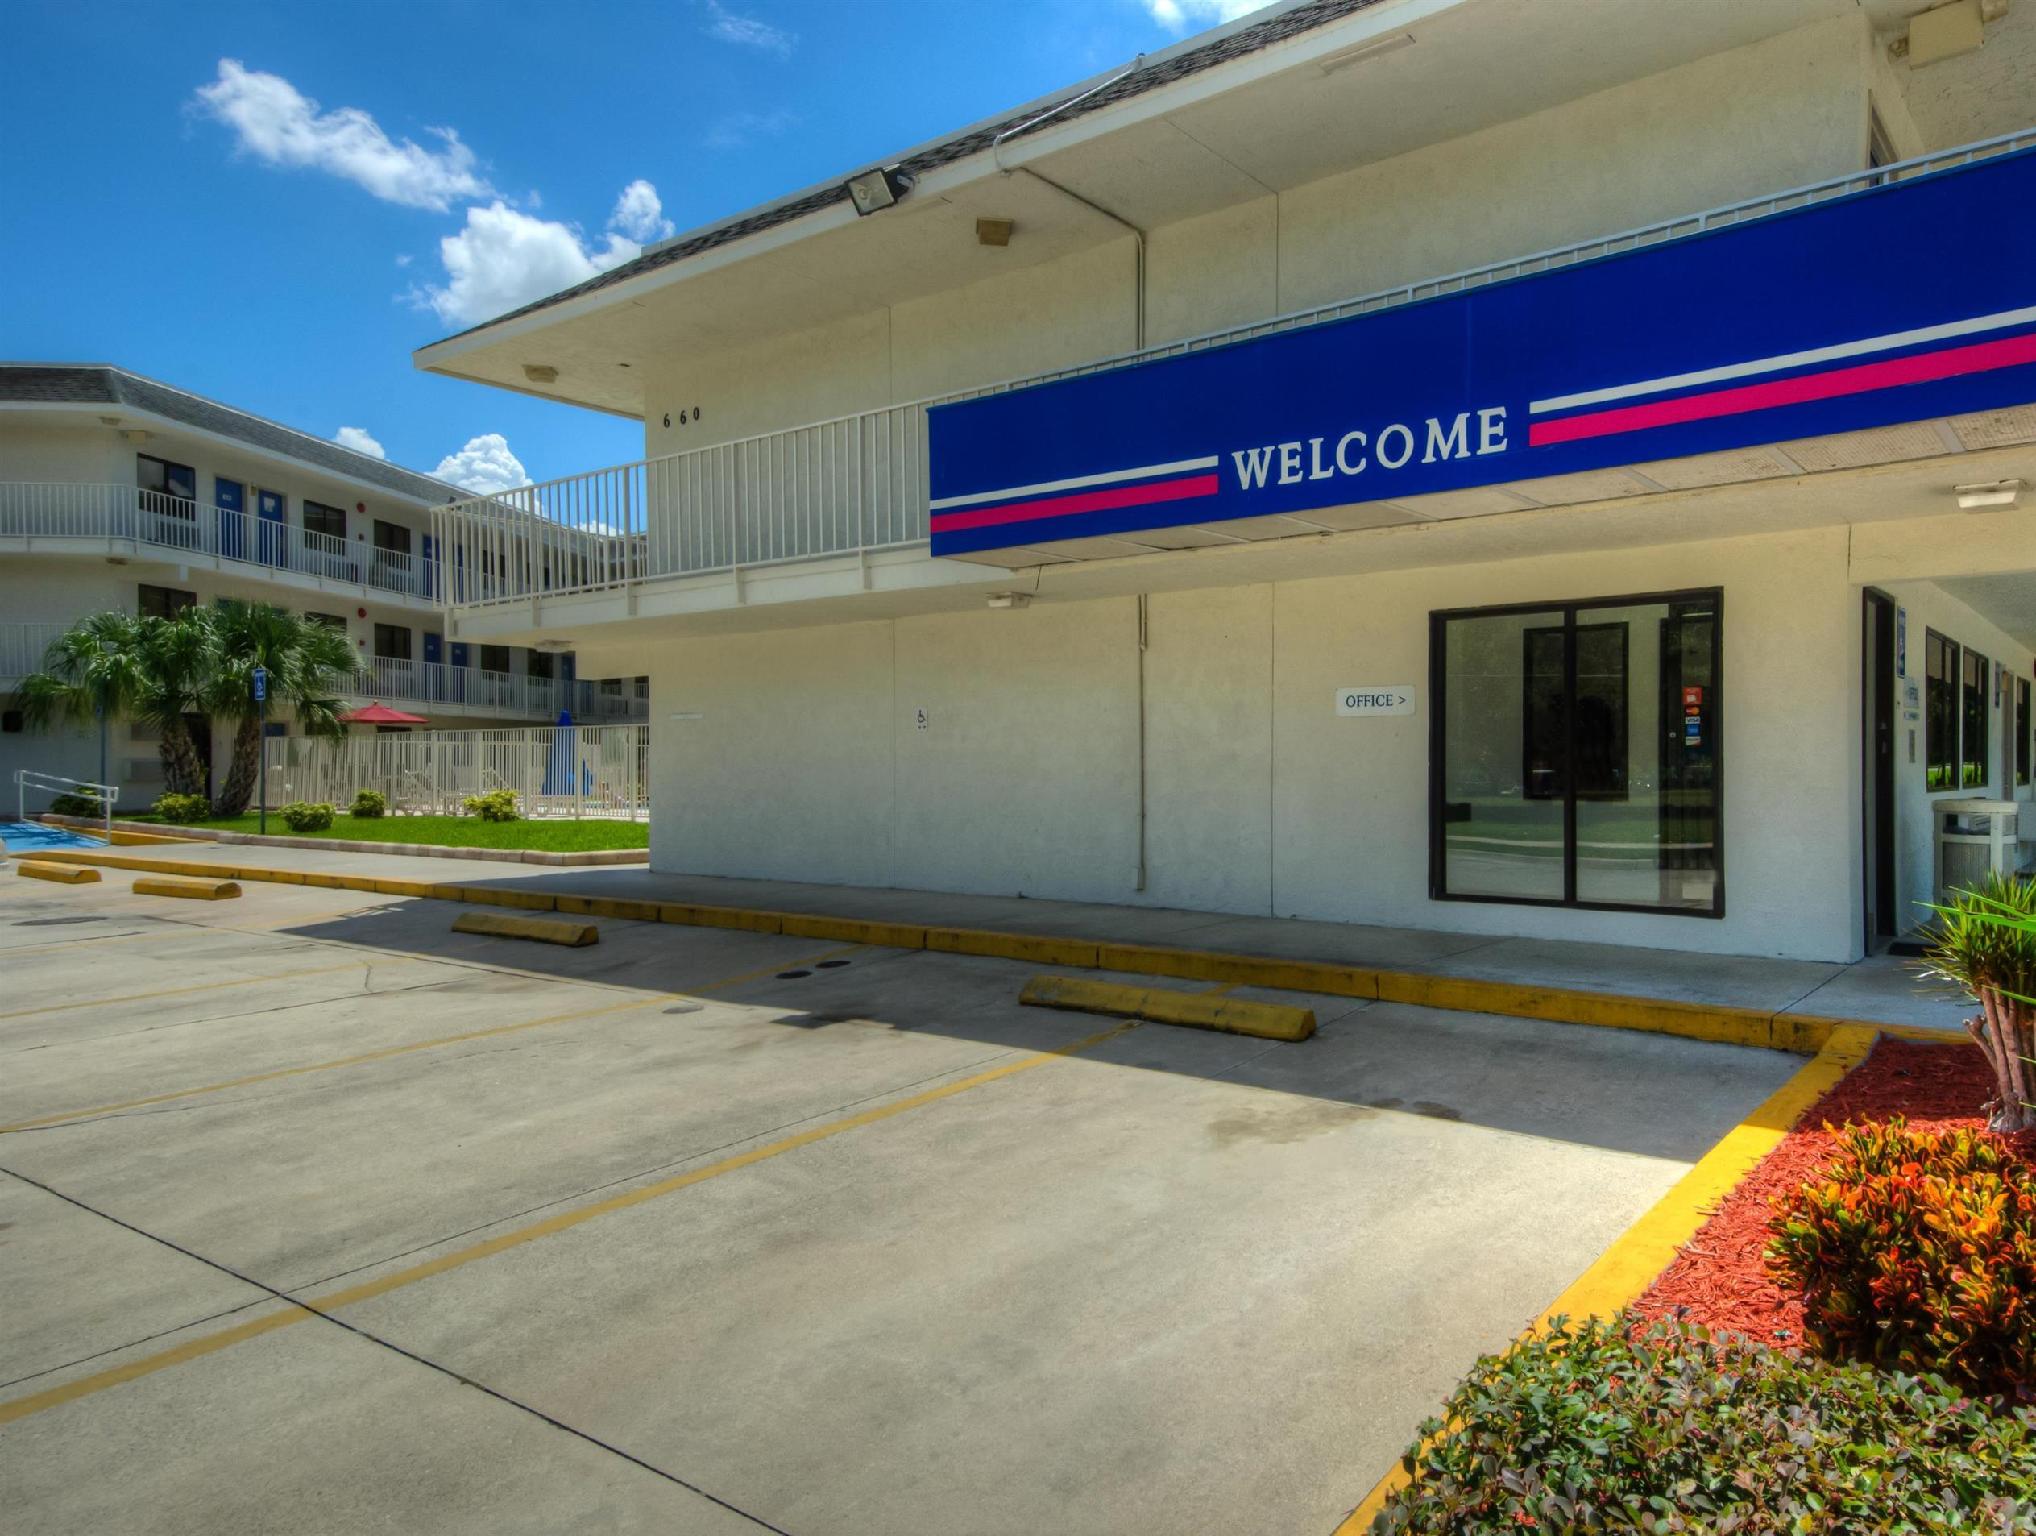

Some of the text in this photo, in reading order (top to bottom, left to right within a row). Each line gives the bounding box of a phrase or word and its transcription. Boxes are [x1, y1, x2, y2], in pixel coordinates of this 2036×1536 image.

[663, 406, 700, 428] 660
[1232, 407, 1508, 490] WELCOME
[1345, 694, 1393, 708] OFFICE
